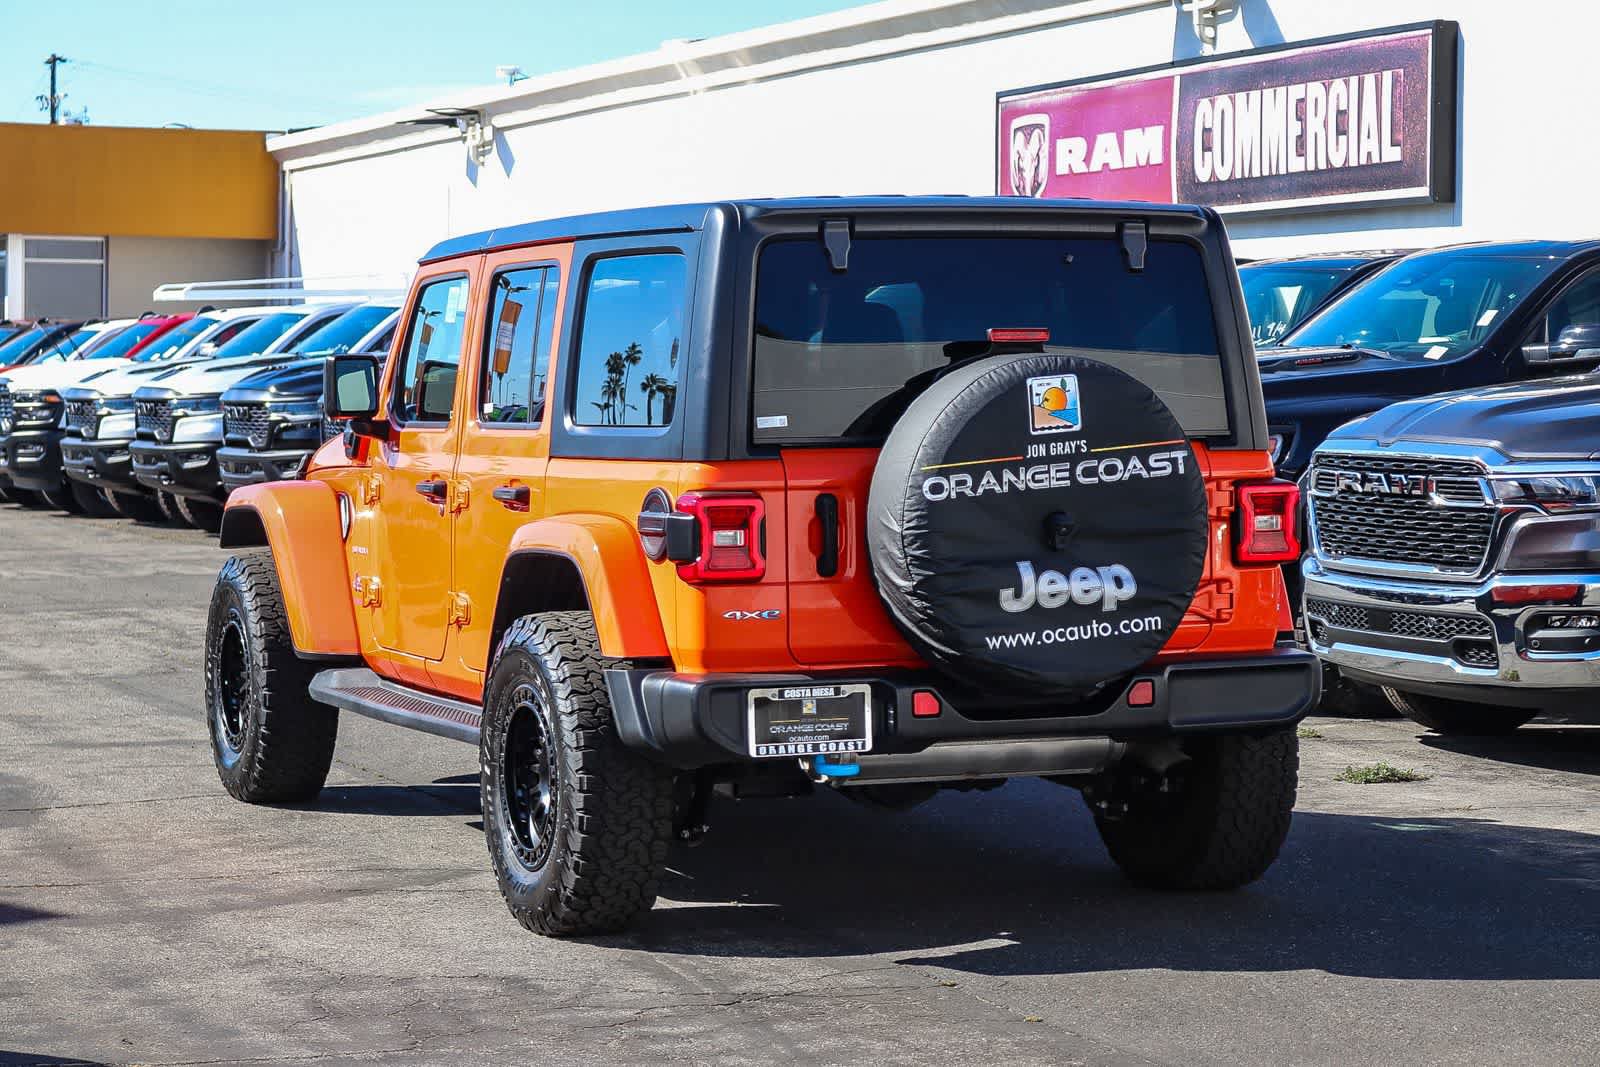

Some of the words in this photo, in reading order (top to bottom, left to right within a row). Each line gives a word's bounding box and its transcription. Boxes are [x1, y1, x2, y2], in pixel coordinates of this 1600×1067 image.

[1193, 69, 1404, 184] COMMERCIAL
[1055, 125, 1164, 176] RAM
[1026, 443, 1046, 458] JON
[1050, 439, 1088, 456] GRAY'S
[921, 462, 1071, 502] ORANGE
[1076, 450, 1189, 485] COAST
[1336, 470, 1427, 495] RAM
[999, 560, 1138, 613] Jeep
[723, 609, 781, 621] 4xe
[985, 614, 1162, 650] www.ocauto.com
[784, 688, 811, 698] COSTA
[812, 687, 835, 697] MESA
[769, 724, 814, 734] ORANGE
[814, 722, 849, 732] COAST
[788, 734, 830, 742] ocauto.com
[759, 743, 813, 755] ORANGE
[819, 741, 864, 753] COAST
